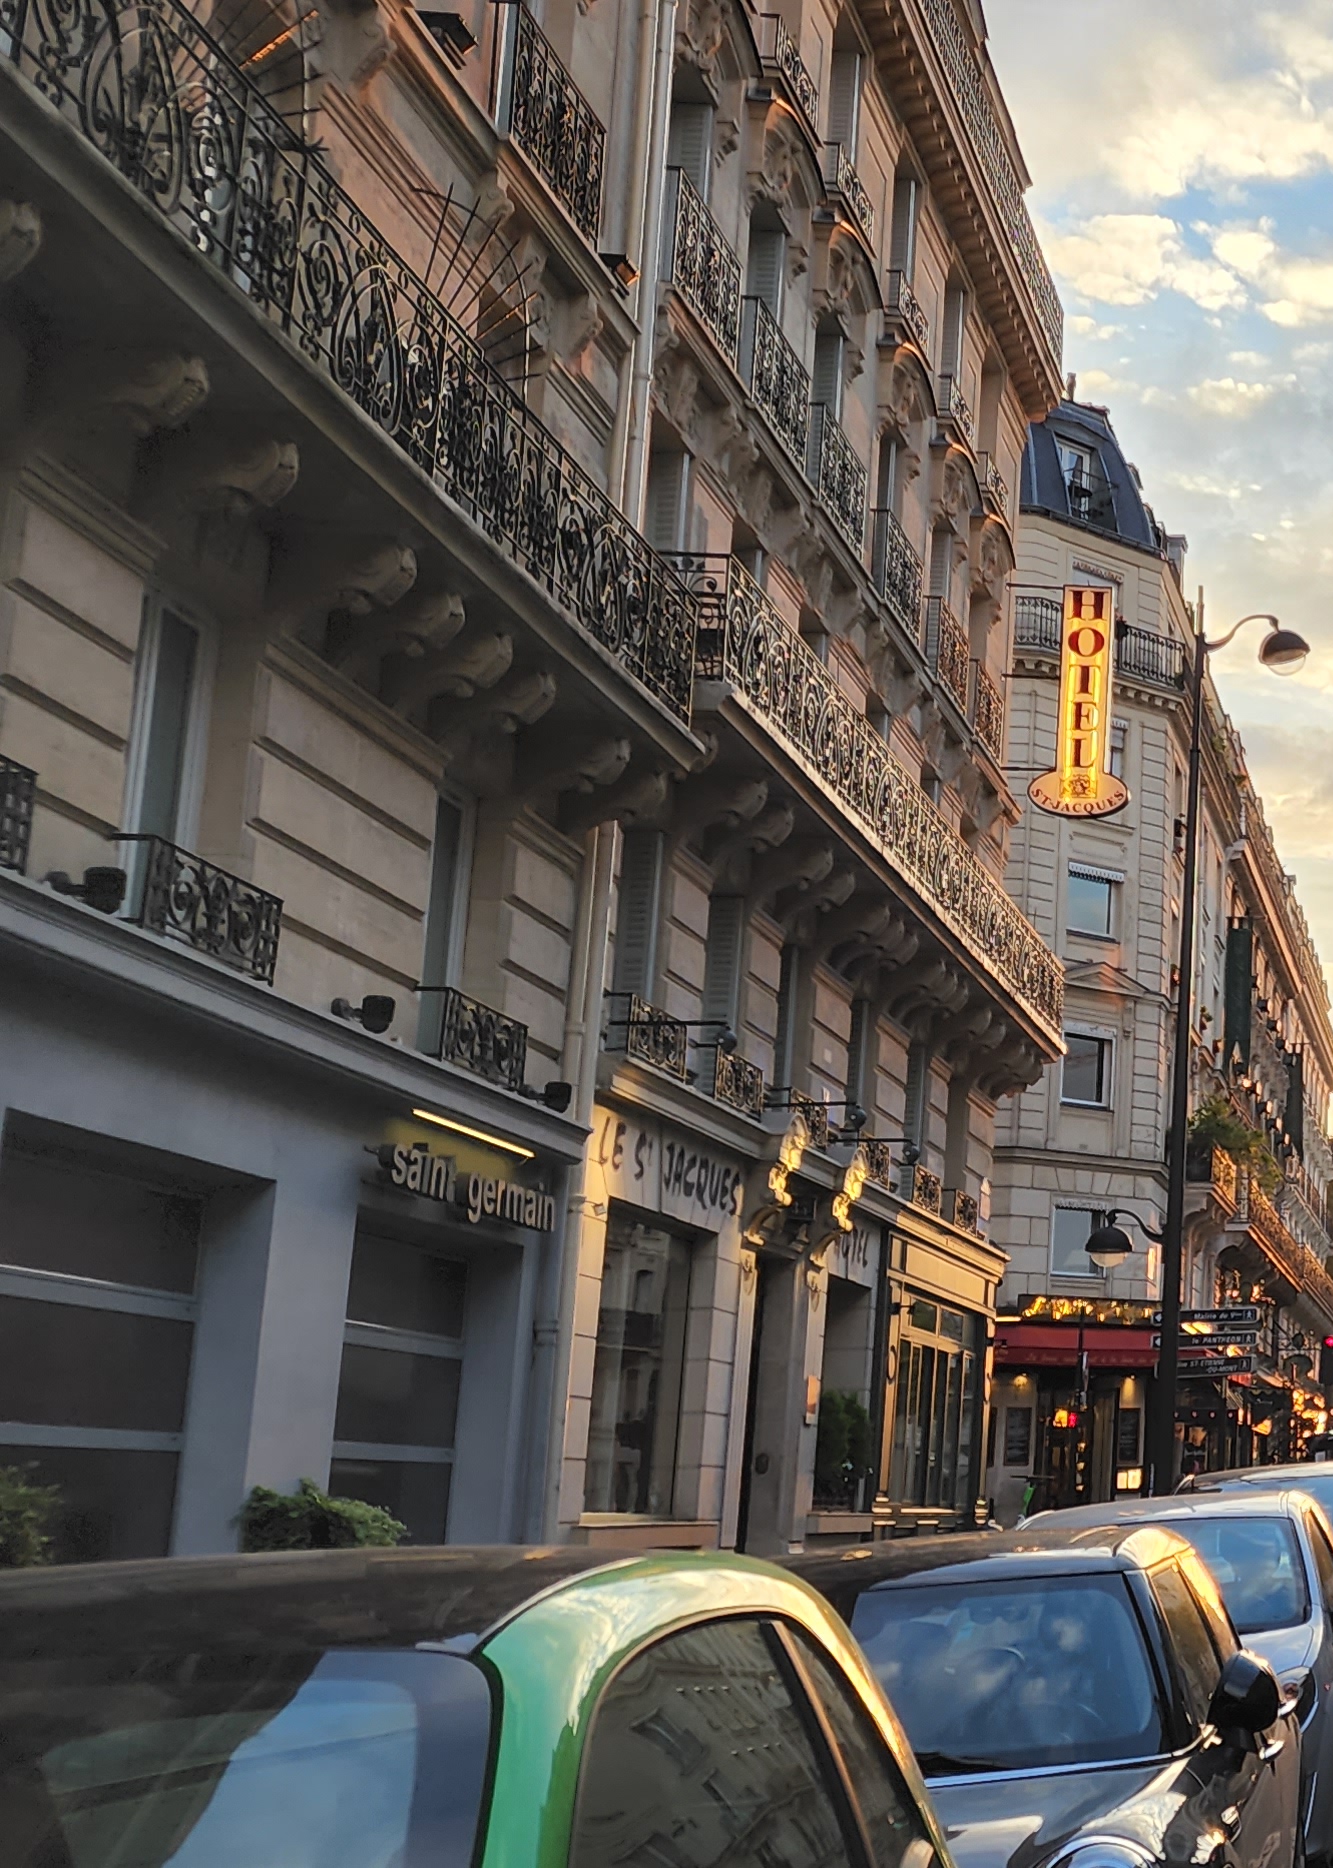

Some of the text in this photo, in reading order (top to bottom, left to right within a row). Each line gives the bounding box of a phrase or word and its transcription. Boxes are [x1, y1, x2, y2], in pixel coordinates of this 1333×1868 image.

[1067, 590, 1109, 769] HOTEL
[1031, 788, 1126, 815] ST-JACQUES
[391, 1143, 556, 1233] saint germain
[599, 1116, 627, 1171] LE
[664, 1142, 741, 1216] JACQUES
